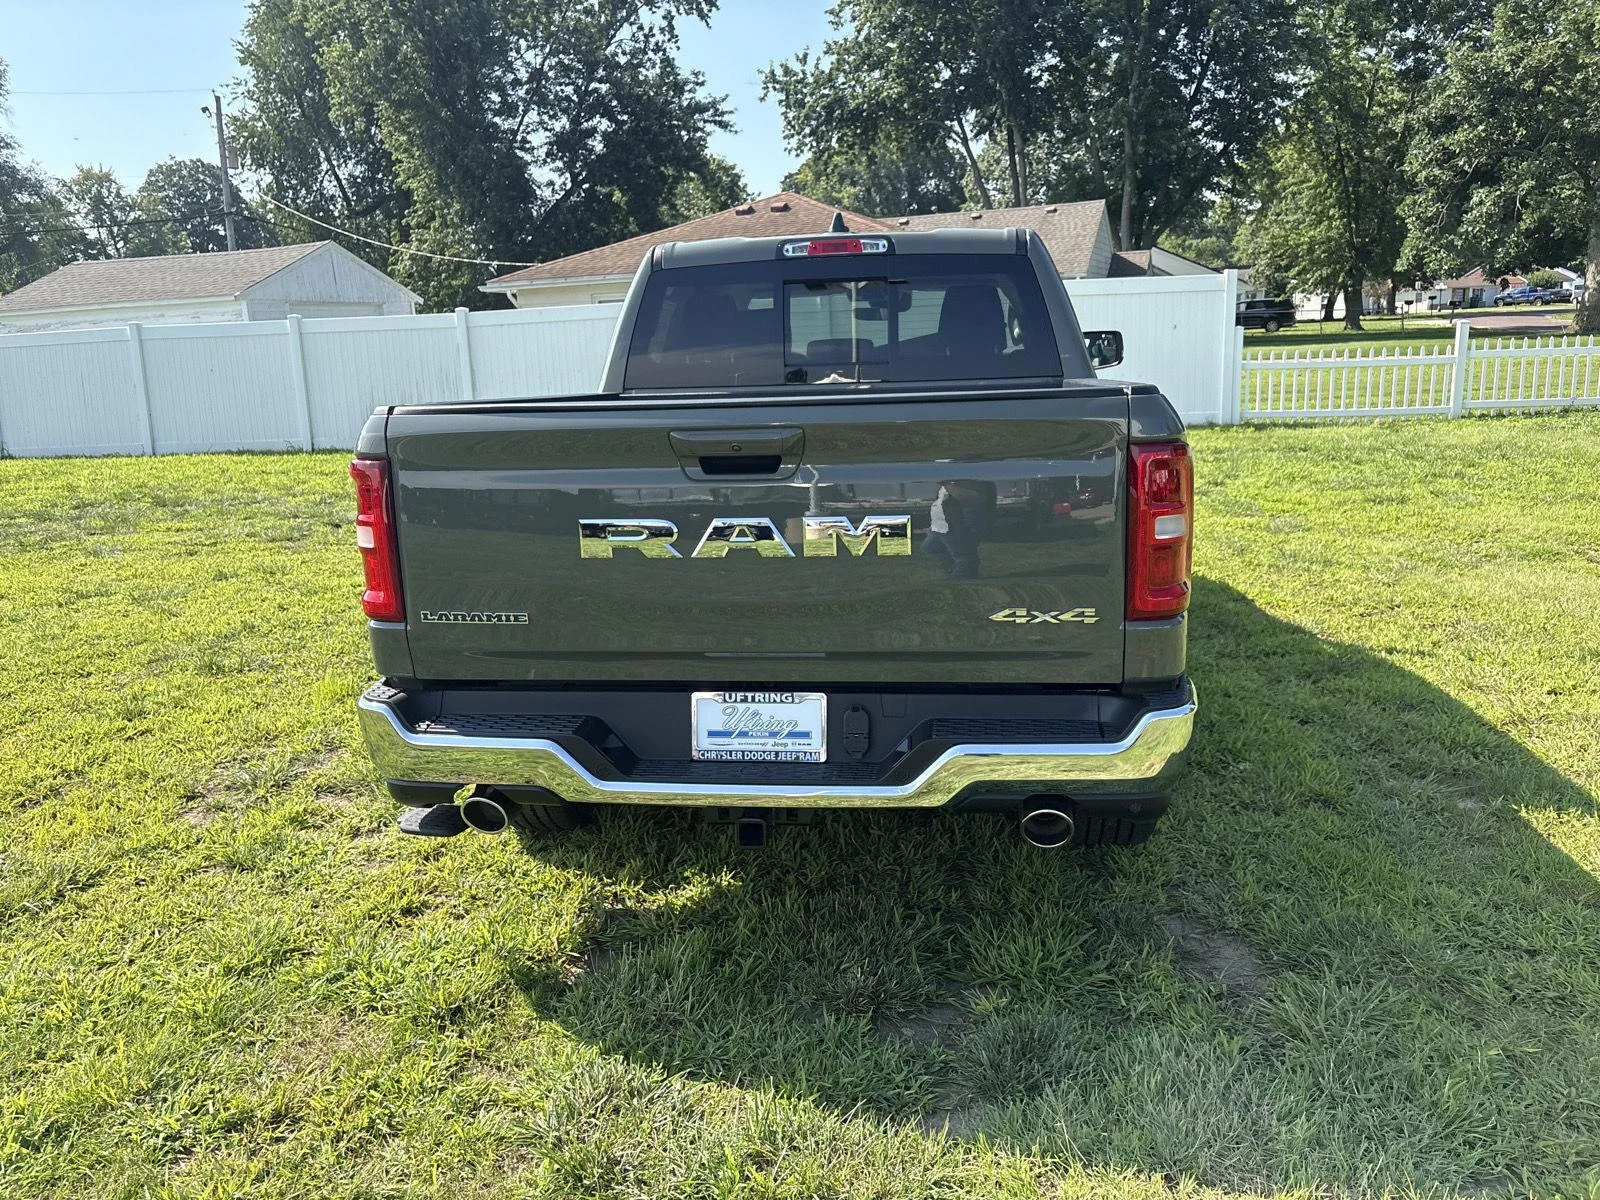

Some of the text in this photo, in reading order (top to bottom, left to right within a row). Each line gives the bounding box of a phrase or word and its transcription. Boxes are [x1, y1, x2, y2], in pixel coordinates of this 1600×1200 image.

[578, 515, 912, 559] RAM
[420, 610, 528, 624] LARAMIE
[724, 692, 794, 703] UFTRING
[721, 704, 799, 740] Uftring
[699, 750, 743, 760] CHRYSLER
[744, 751, 776, 760] DODGE
[799, 751, 820, 761] RAM
